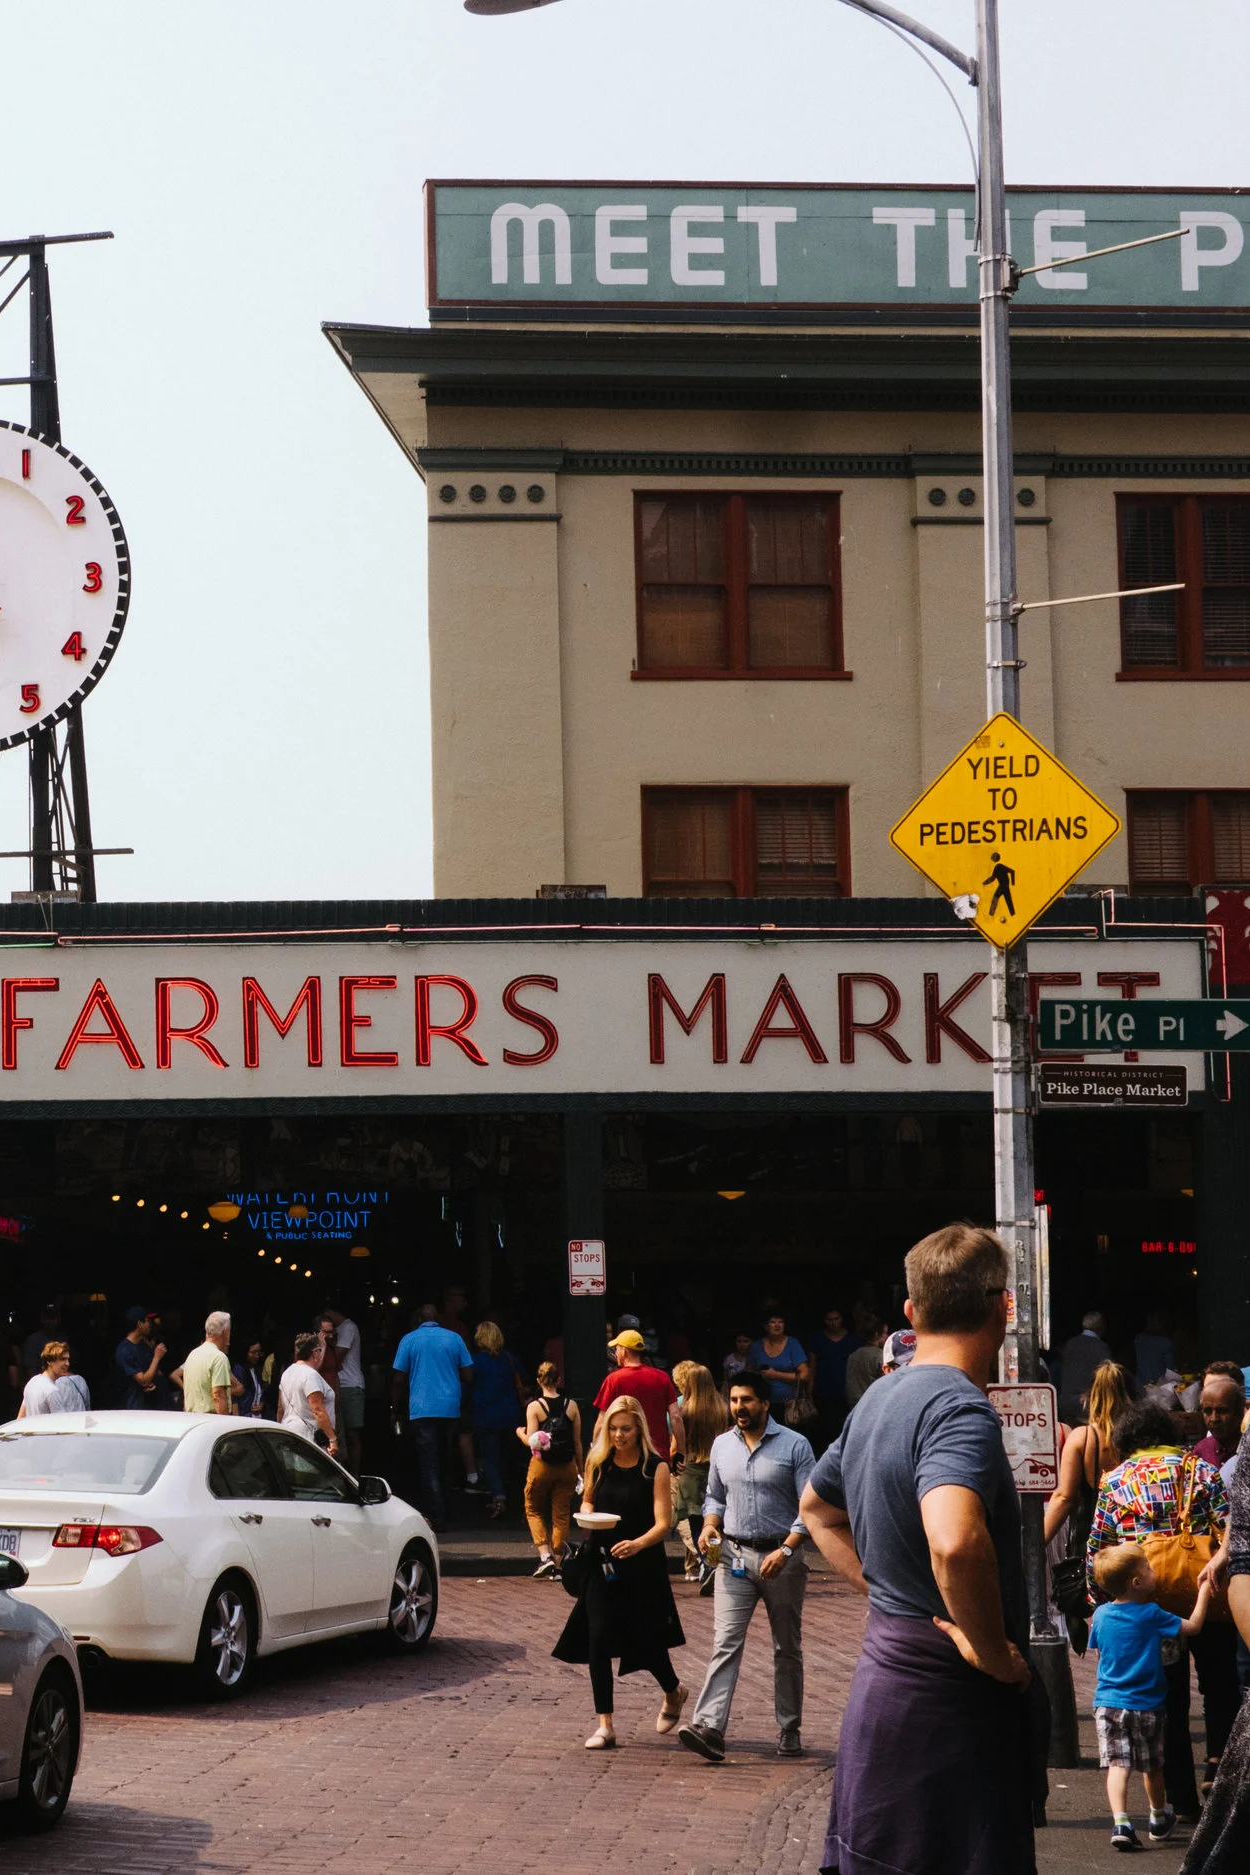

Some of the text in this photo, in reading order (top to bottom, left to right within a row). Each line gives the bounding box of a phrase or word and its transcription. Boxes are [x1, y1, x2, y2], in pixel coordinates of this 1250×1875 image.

[490, 202, 797, 286] MEET
[872, 206, 1088, 290] THE
[21, 449, 31, 479] 1
[65, 495, 86, 525] 2
[82, 562, 103, 592] 3
[61, 631, 87, 661] 4
[19, 683, 41, 713] 5
[967, 754, 1040, 780] YIELD
[987, 787, 1018, 811] TO
[919, 815, 1088, 846] PEDESTRIANS
[1, 974, 560, 1070] FARMERS
[1054, 1003, 1185, 1042] Pike Pl
[1046, 1082, 1181, 1097] Pike Place Market
[1063, 1070, 1164, 1079] HISTORICAL DISTRICT
[247, 1210, 372, 1229] VIEWPOINT
[275, 1232, 308, 1240] PUBLIC
[311, 1231, 352, 1240] SEATING
[571, 1243, 581, 1251] NO
[574, 1253, 601, 1263] STOPS
